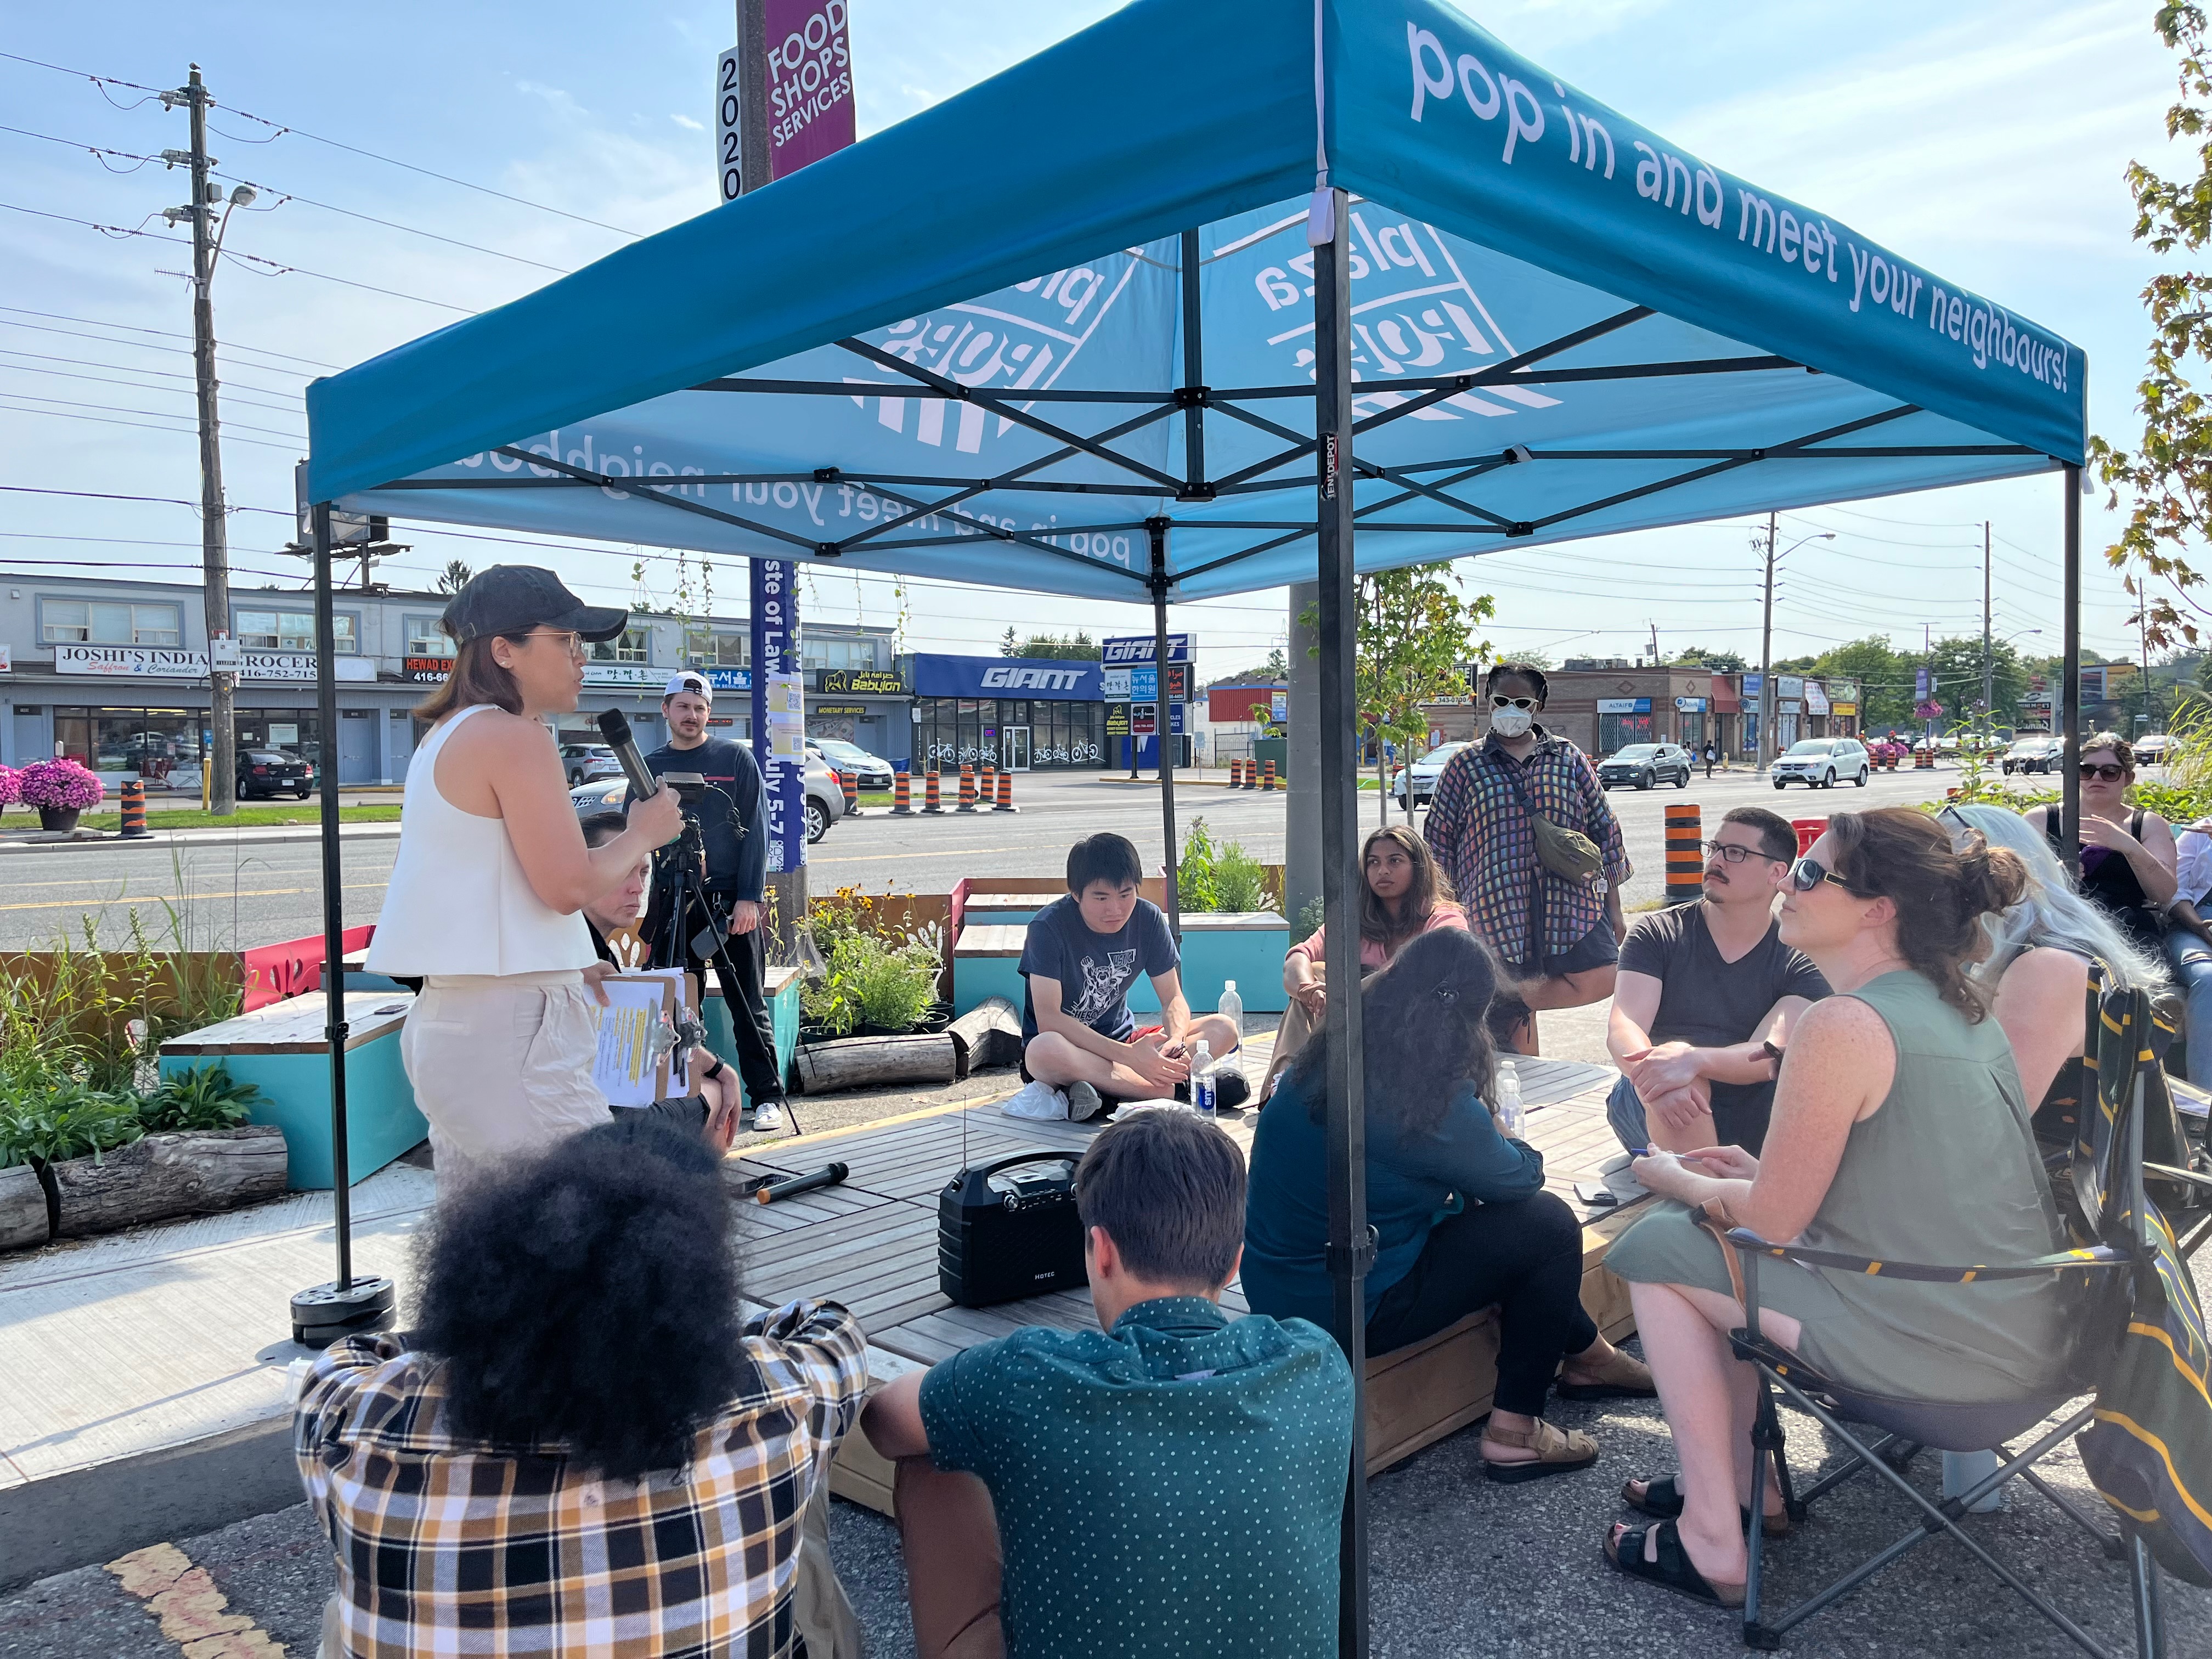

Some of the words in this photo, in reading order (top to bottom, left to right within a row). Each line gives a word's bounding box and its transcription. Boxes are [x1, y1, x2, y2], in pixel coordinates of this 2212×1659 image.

[768, 0, 847, 83] FOOD
[771, 36, 848, 117] SHOPS
[772, 72, 851, 148] SERVICES
[721, 58, 741, 200] 2020
[1406, 21, 1545, 163] pop
[1553, 81, 1615, 179] in
[1635, 139, 1723, 229] and
[1738, 187, 1838, 282] meet
[1847, 241, 1922, 319] your
[1929, 284, 2068, 393] neighbours!
[765, 601, 783, 625] of
[63, 647, 145, 664] JOSHI'S
[406, 658, 439, 671] HEWAD
[87, 661, 129, 673] Saffron
[133, 664, 142, 673] &
[147, 663, 198, 675] Coriander
[980, 667, 1088, 690] GIANT
[1132, 674, 1156, 684] 뉴서울
[851, 679, 901, 694] Babylon
[768, 799, 784, 834] 5-7
